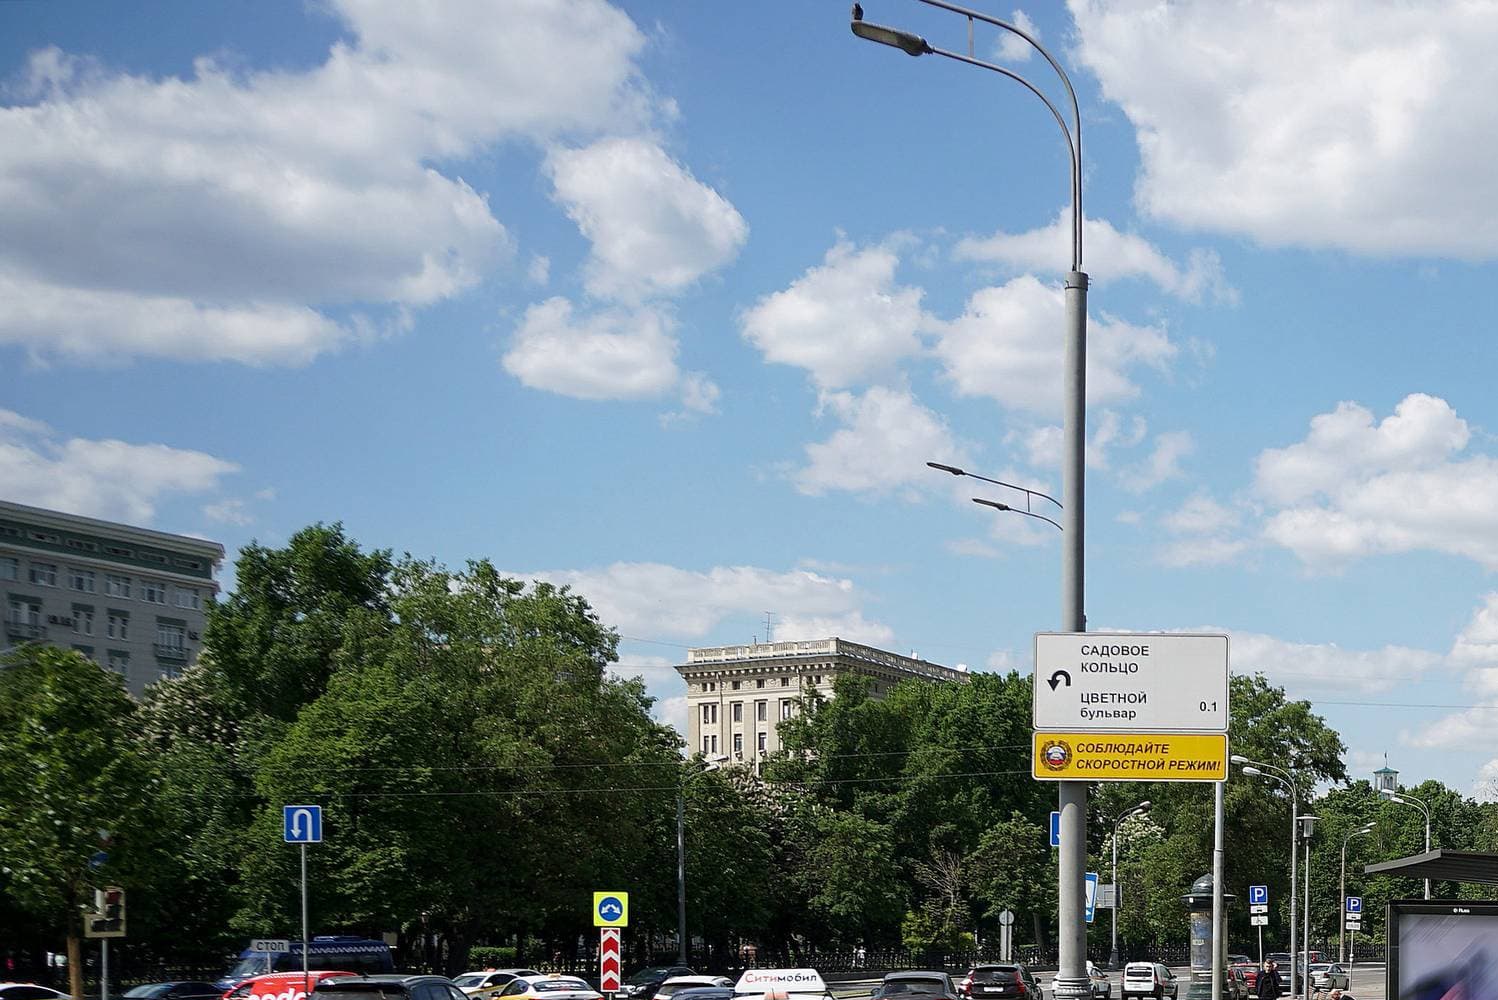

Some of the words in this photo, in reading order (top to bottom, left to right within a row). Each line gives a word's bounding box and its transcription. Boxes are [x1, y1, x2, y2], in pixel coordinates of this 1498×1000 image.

[1081, 645, 1150, 657] САДОВОЕ
[1081, 662, 1138, 675] КОЛЬЦО
[1081, 692, 1147, 705] ЦВЕТНОЙ
[1199, 701, 1218, 712] 0.1
[1080, 708, 1137, 720] бульвар
[1076, 743, 1170, 756] СОБЛЮДАЙТЕ
[1076, 758, 1166, 770] СКОРОСТНОЙ
[1169, 760, 1221, 771] РЕЖИМ!
[1254, 888, 1264, 901] P
[1350, 899, 1359, 910] P
[256, 941, 285, 951] СТОП
[745, 973, 817, 983] Ситимобил
